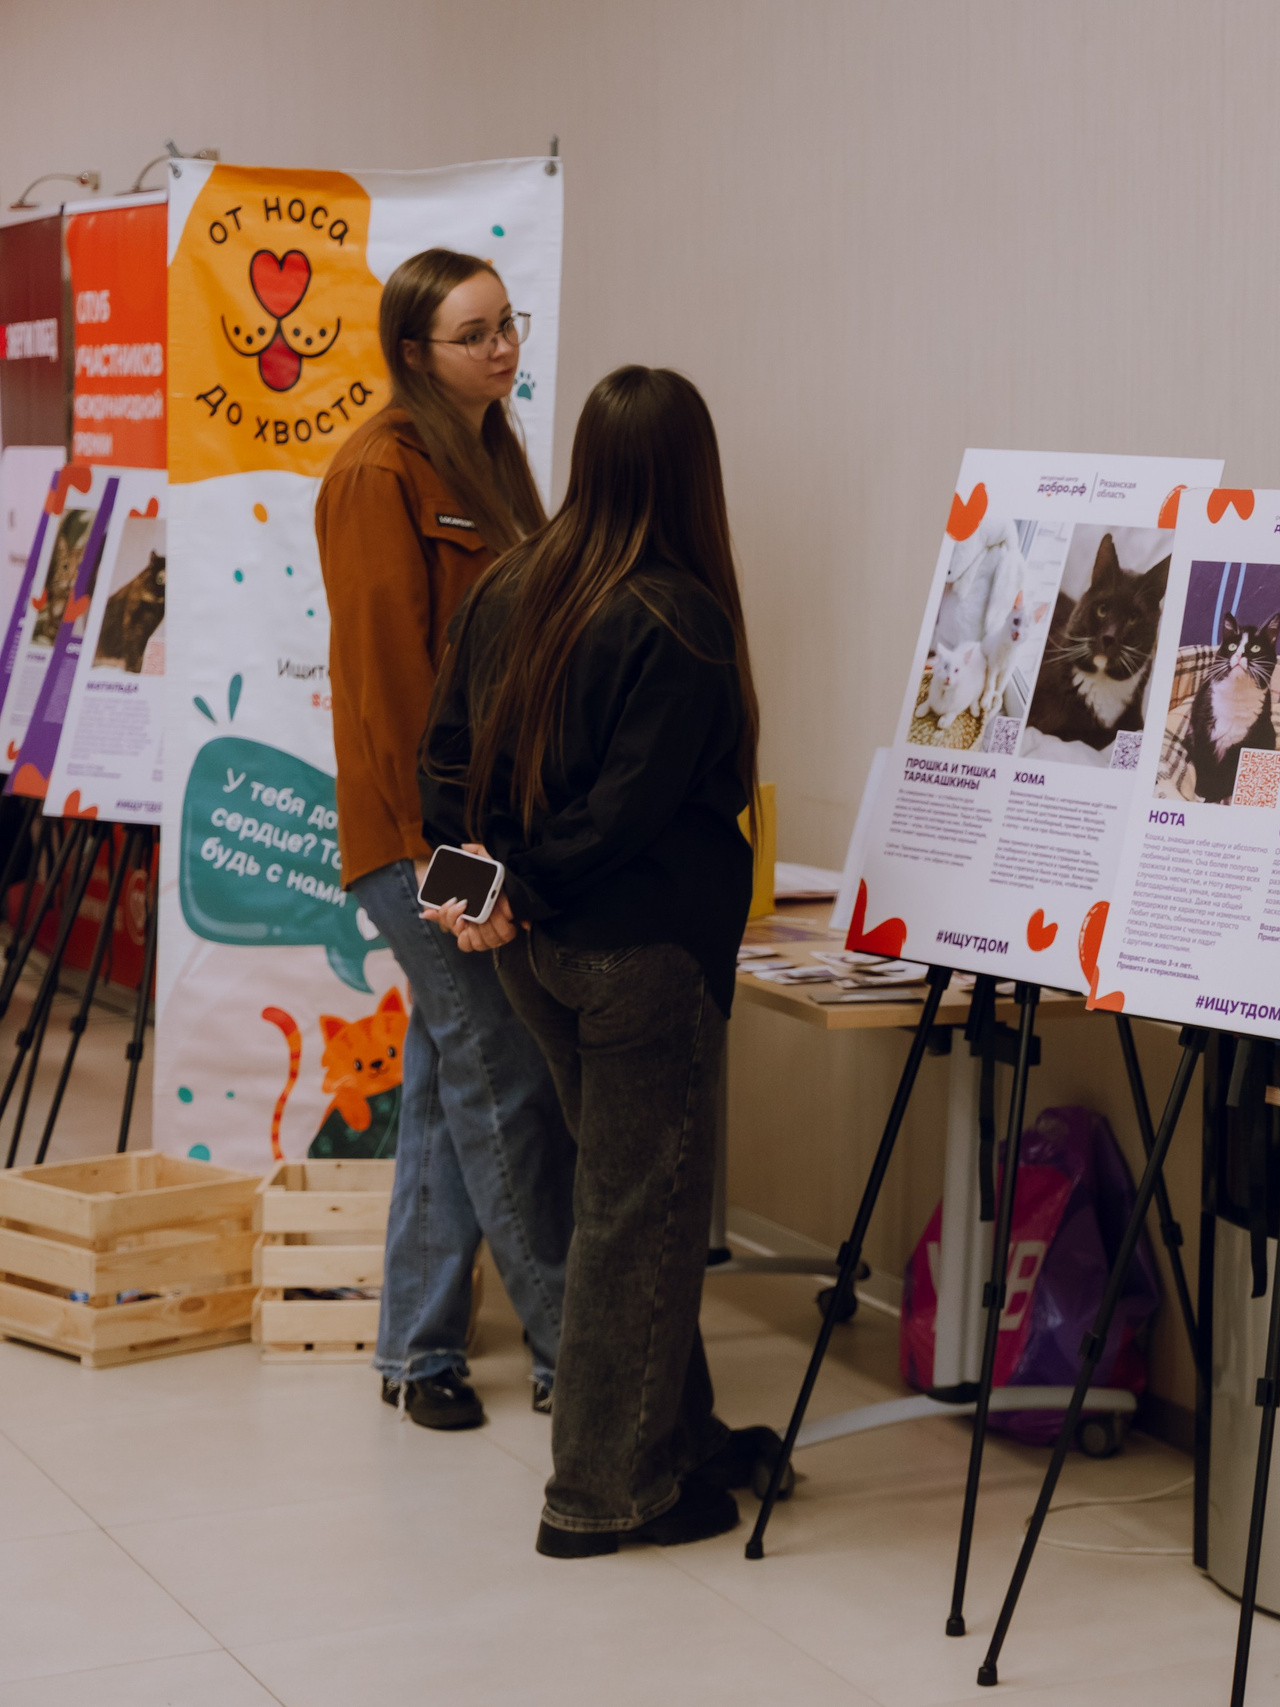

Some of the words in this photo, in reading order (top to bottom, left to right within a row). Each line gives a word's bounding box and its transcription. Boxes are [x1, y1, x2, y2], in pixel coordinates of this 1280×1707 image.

[209, 206, 243, 244] ОТ
[277, 658, 329, 681] Ищит
[905, 758, 949, 773] ПРОШКА
[951, 764, 958, 774] И
[961, 764, 997, 779] ТИШКА
[1013, 772, 1046, 786] ХОМА
[903, 771, 980, 790] ТАРАКАШКИНЫ
[222, 768, 246, 793] У
[250, 780, 306, 818] тебя
[1149, 810, 1186, 827] НОТА
[211, 807, 318, 858] сердце?
[200, 837, 261, 877] будь
[266, 863, 283, 883] с
[286, 869, 347, 908] нами
[936, 930, 1009, 954] #ИЩУТДОМ
